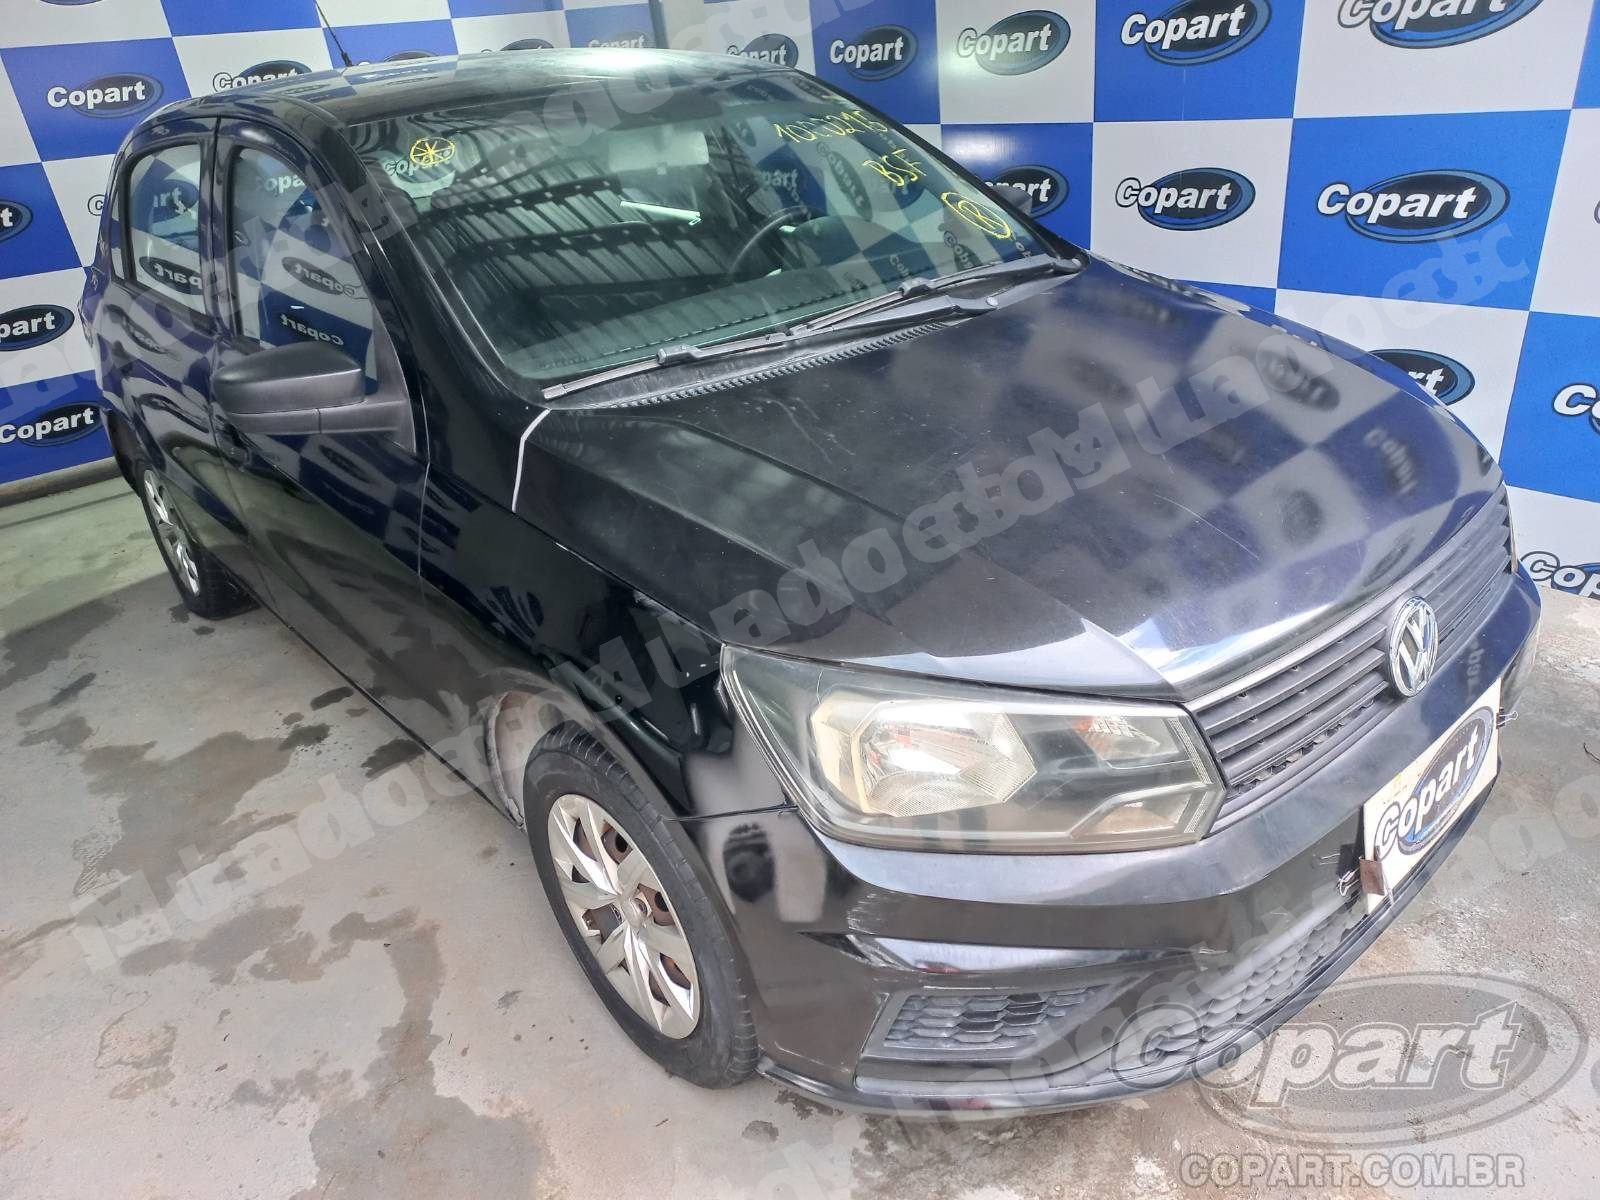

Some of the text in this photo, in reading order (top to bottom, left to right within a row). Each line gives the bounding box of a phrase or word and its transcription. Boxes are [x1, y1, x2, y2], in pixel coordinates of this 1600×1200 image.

[956, 23, 1052, 60] Copart
[1120, 4, 1247, 50] Copart
[829, 34, 904, 69] Copart
[47, 81, 146, 109] Copart
[1115, 177, 1233, 214] Copart
[1316, 182, 1477, 224] Copart
[0, 407, 95, 440] Copart
[1374, 726, 1479, 861] Copart
